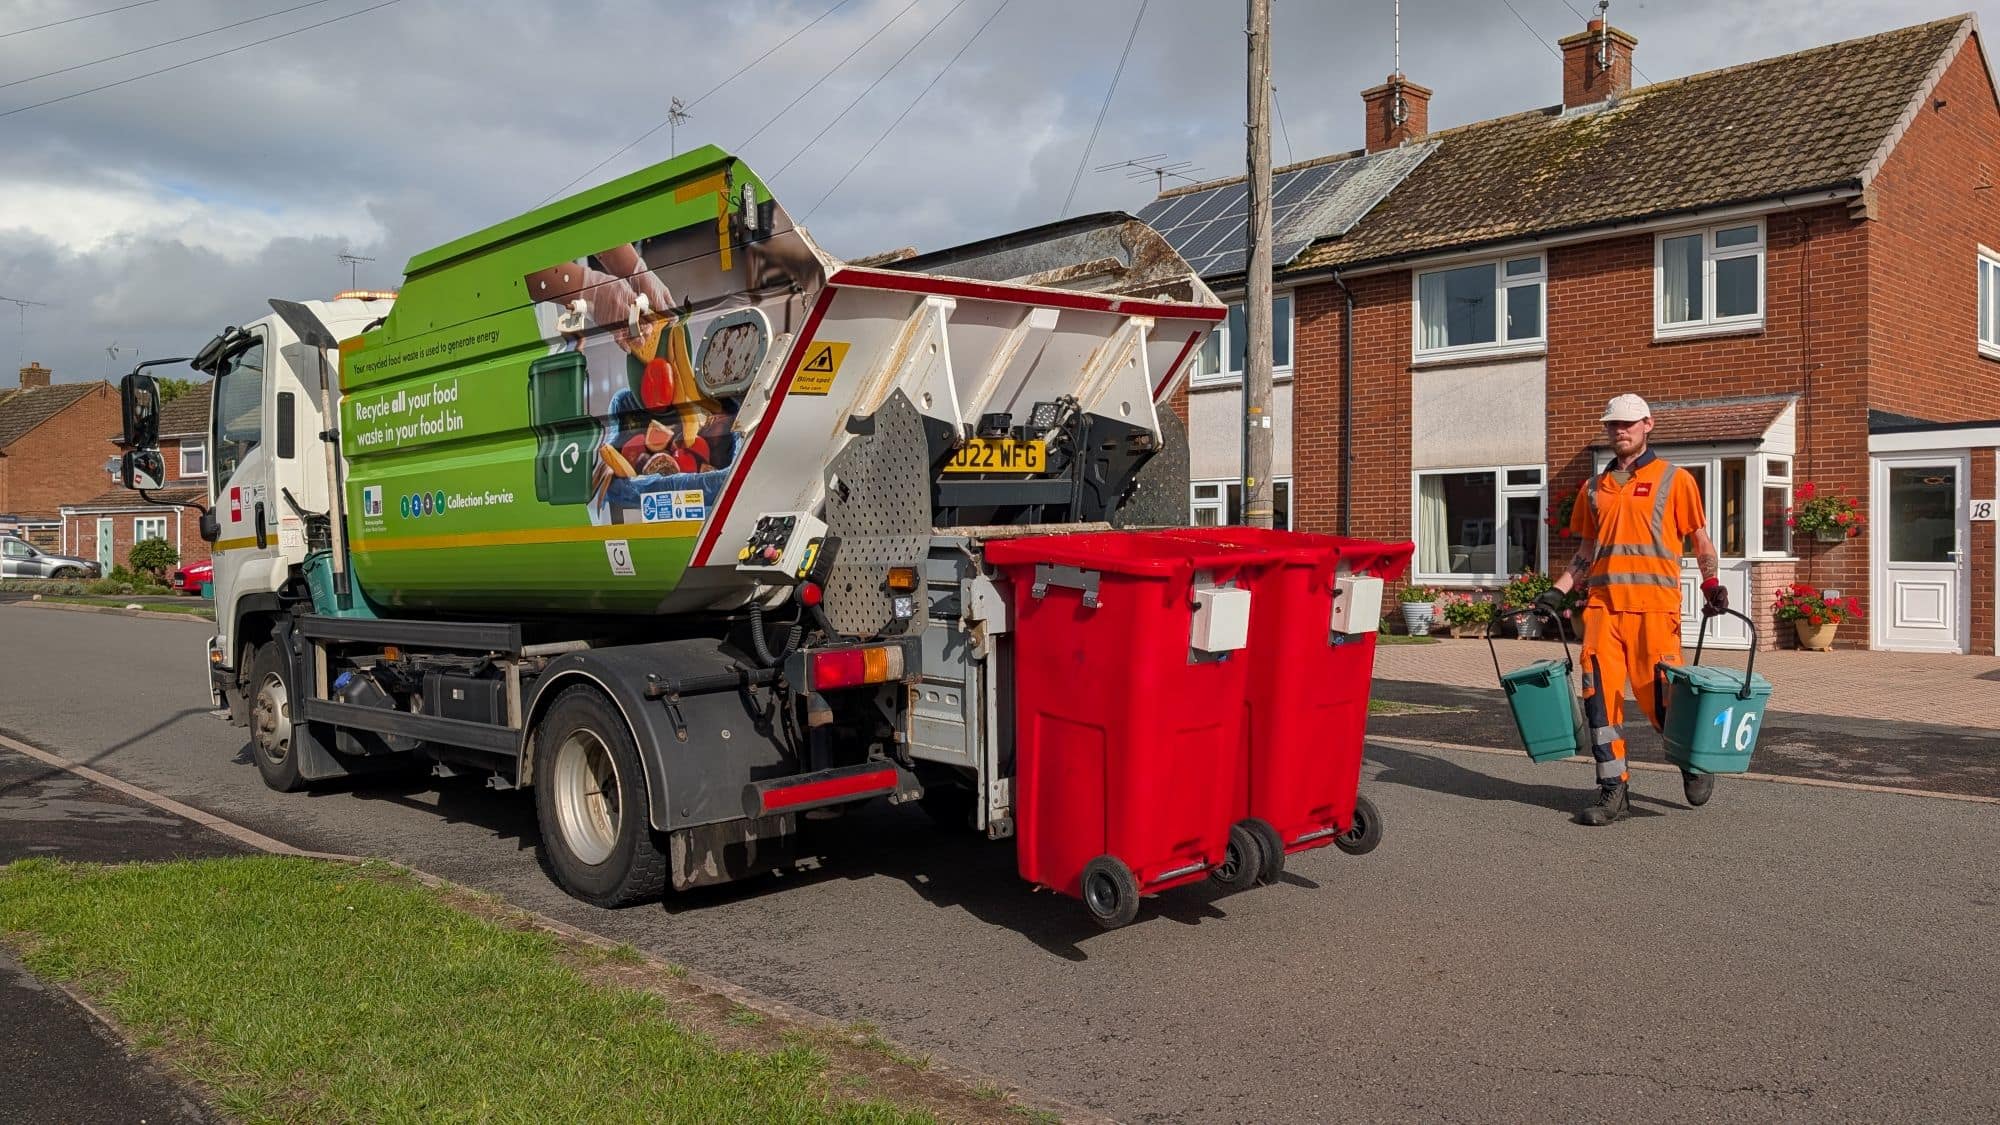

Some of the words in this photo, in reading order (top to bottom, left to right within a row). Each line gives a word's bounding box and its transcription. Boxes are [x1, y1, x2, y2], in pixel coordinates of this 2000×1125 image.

[353, 364, 365, 375] Your
[366, 357, 388, 373] recycled
[388, 354, 400, 366] food
[403, 351, 418, 362] waste
[426, 344, 439, 356] used
[440, 342, 446, 352] to
[447, 335, 476, 354] generate
[476, 329, 500, 344] energy
[356, 396, 390, 424] Recycle
[392, 390, 406, 413] all
[408, 392, 432, 416] your
[434, 378, 458, 405] food
[356, 427, 384, 446] waste
[386, 422, 394, 442] in
[396, 423, 418, 446] your
[420, 410, 444, 436] food
[446, 408, 464, 432] bin
[1000, 444, 1036, 467] WFG
[448, 492, 482, 508] Collection
[484, 488, 514, 504] Service
[1971, 502, 1991, 518] 18
[1713, 706, 1756, 751] 16
